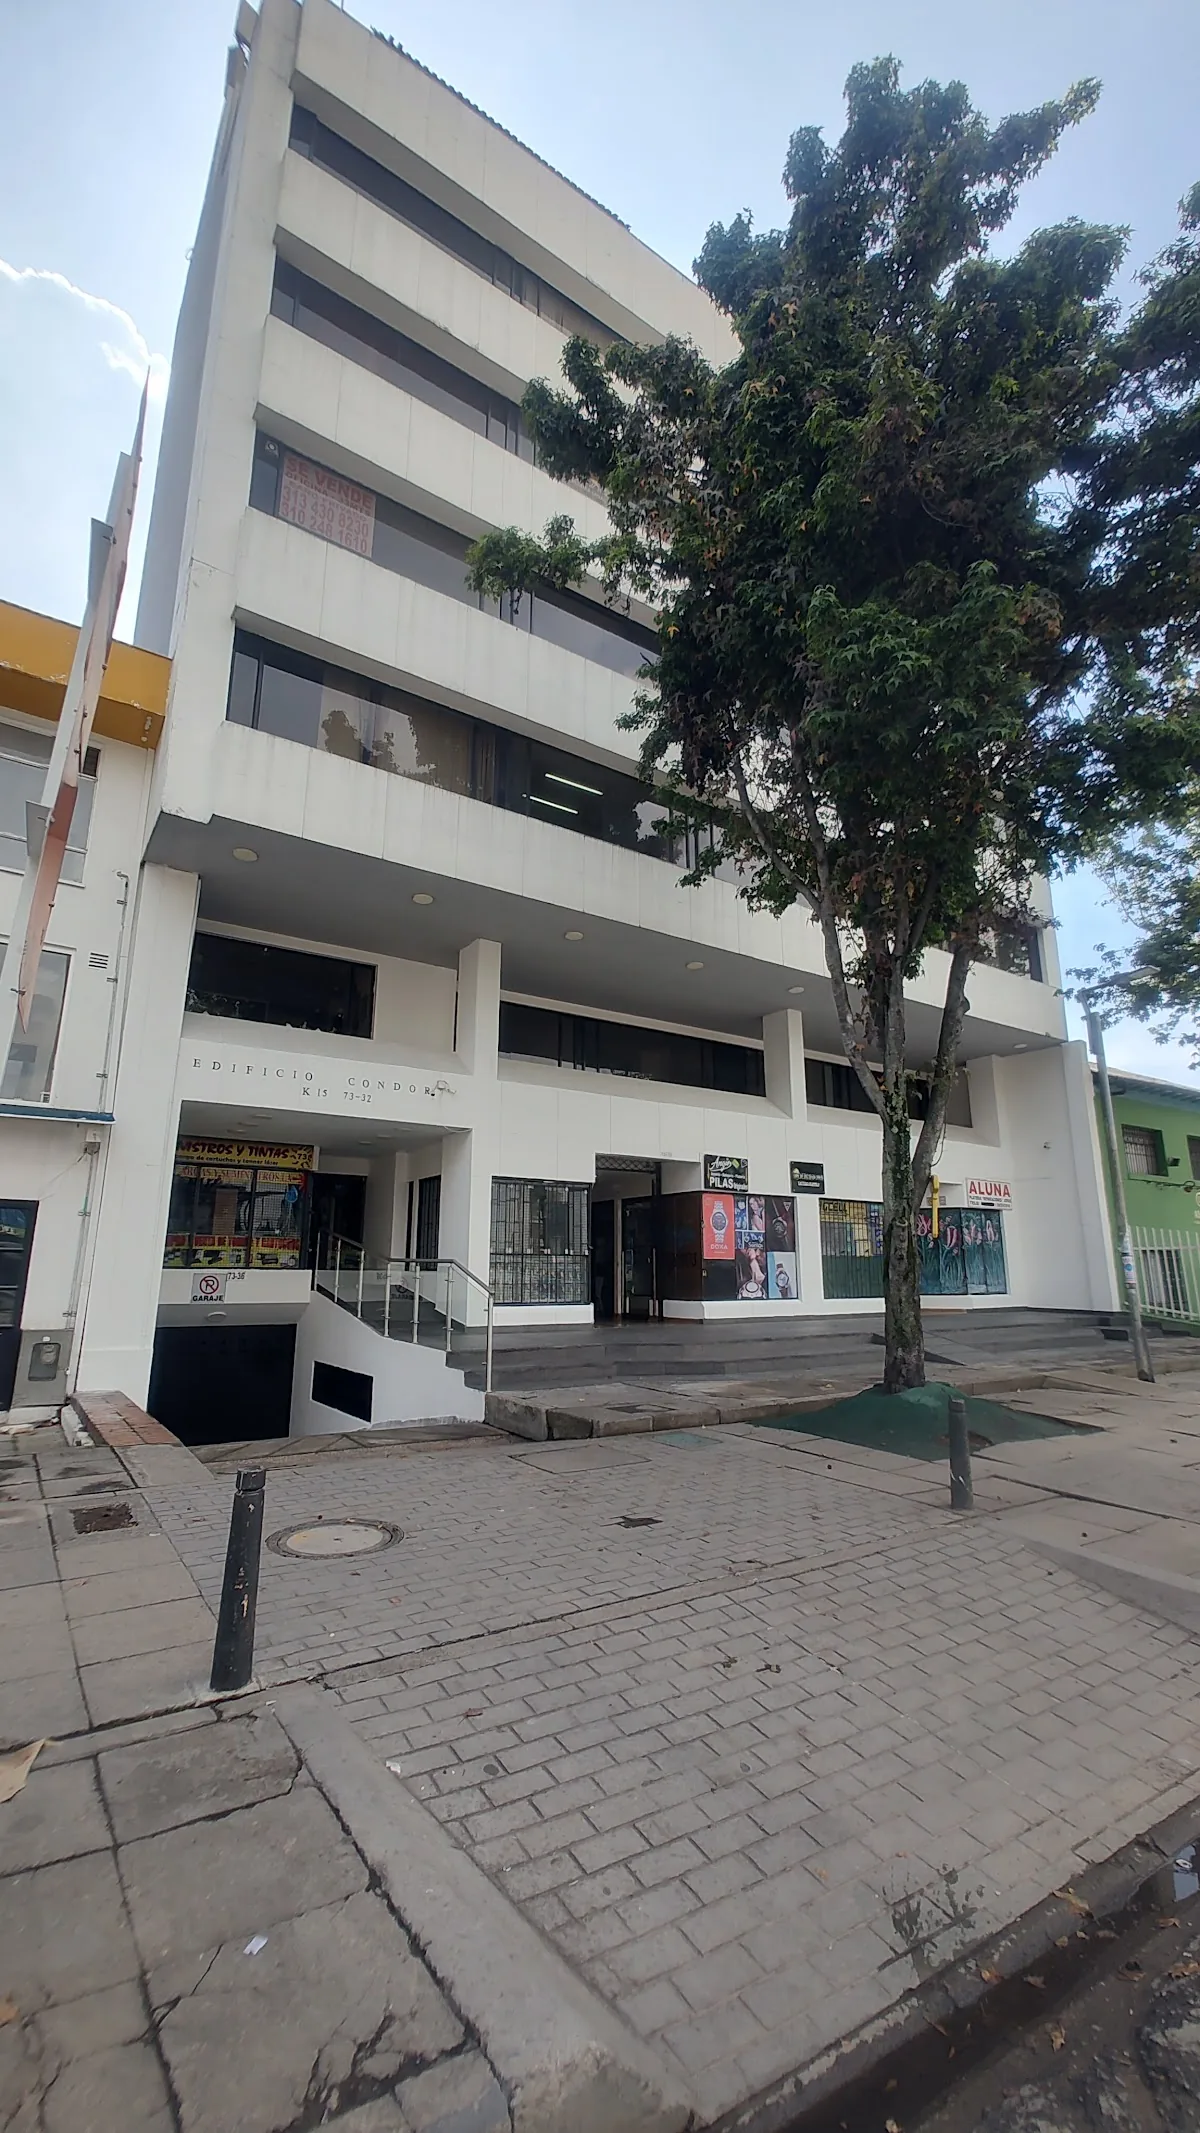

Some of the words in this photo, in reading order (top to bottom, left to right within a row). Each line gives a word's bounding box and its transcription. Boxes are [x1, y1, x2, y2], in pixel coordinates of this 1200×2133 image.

[285, 471, 328, 496] OFICINA
[287, 456, 308, 478] SE
[314, 469, 372, 510] VENDE
[283, 485, 307, 509] 313
[311, 500, 335, 522] 430
[338, 513, 369, 538] 8230
[281, 501, 306, 525] 310
[310, 515, 333, 538] 248
[338, 529, 368, 554] 1610
[193, 1058, 314, 1081] EDIFICIO
[348, 1077, 430, 1095] CONDOR
[302, 1087, 311, 1096] K
[317, 1088, 328, 1097] 15
[343, 1091, 372, 1103] 73-32
[236, 1144, 245, 1157] Y
[248, 1145, 289, 1159] TINTAS
[709, 1176, 734, 1189] PILAS
[969, 1181, 1011, 1197] ALUNA
[192, 1294, 224, 1302] GARAJE
